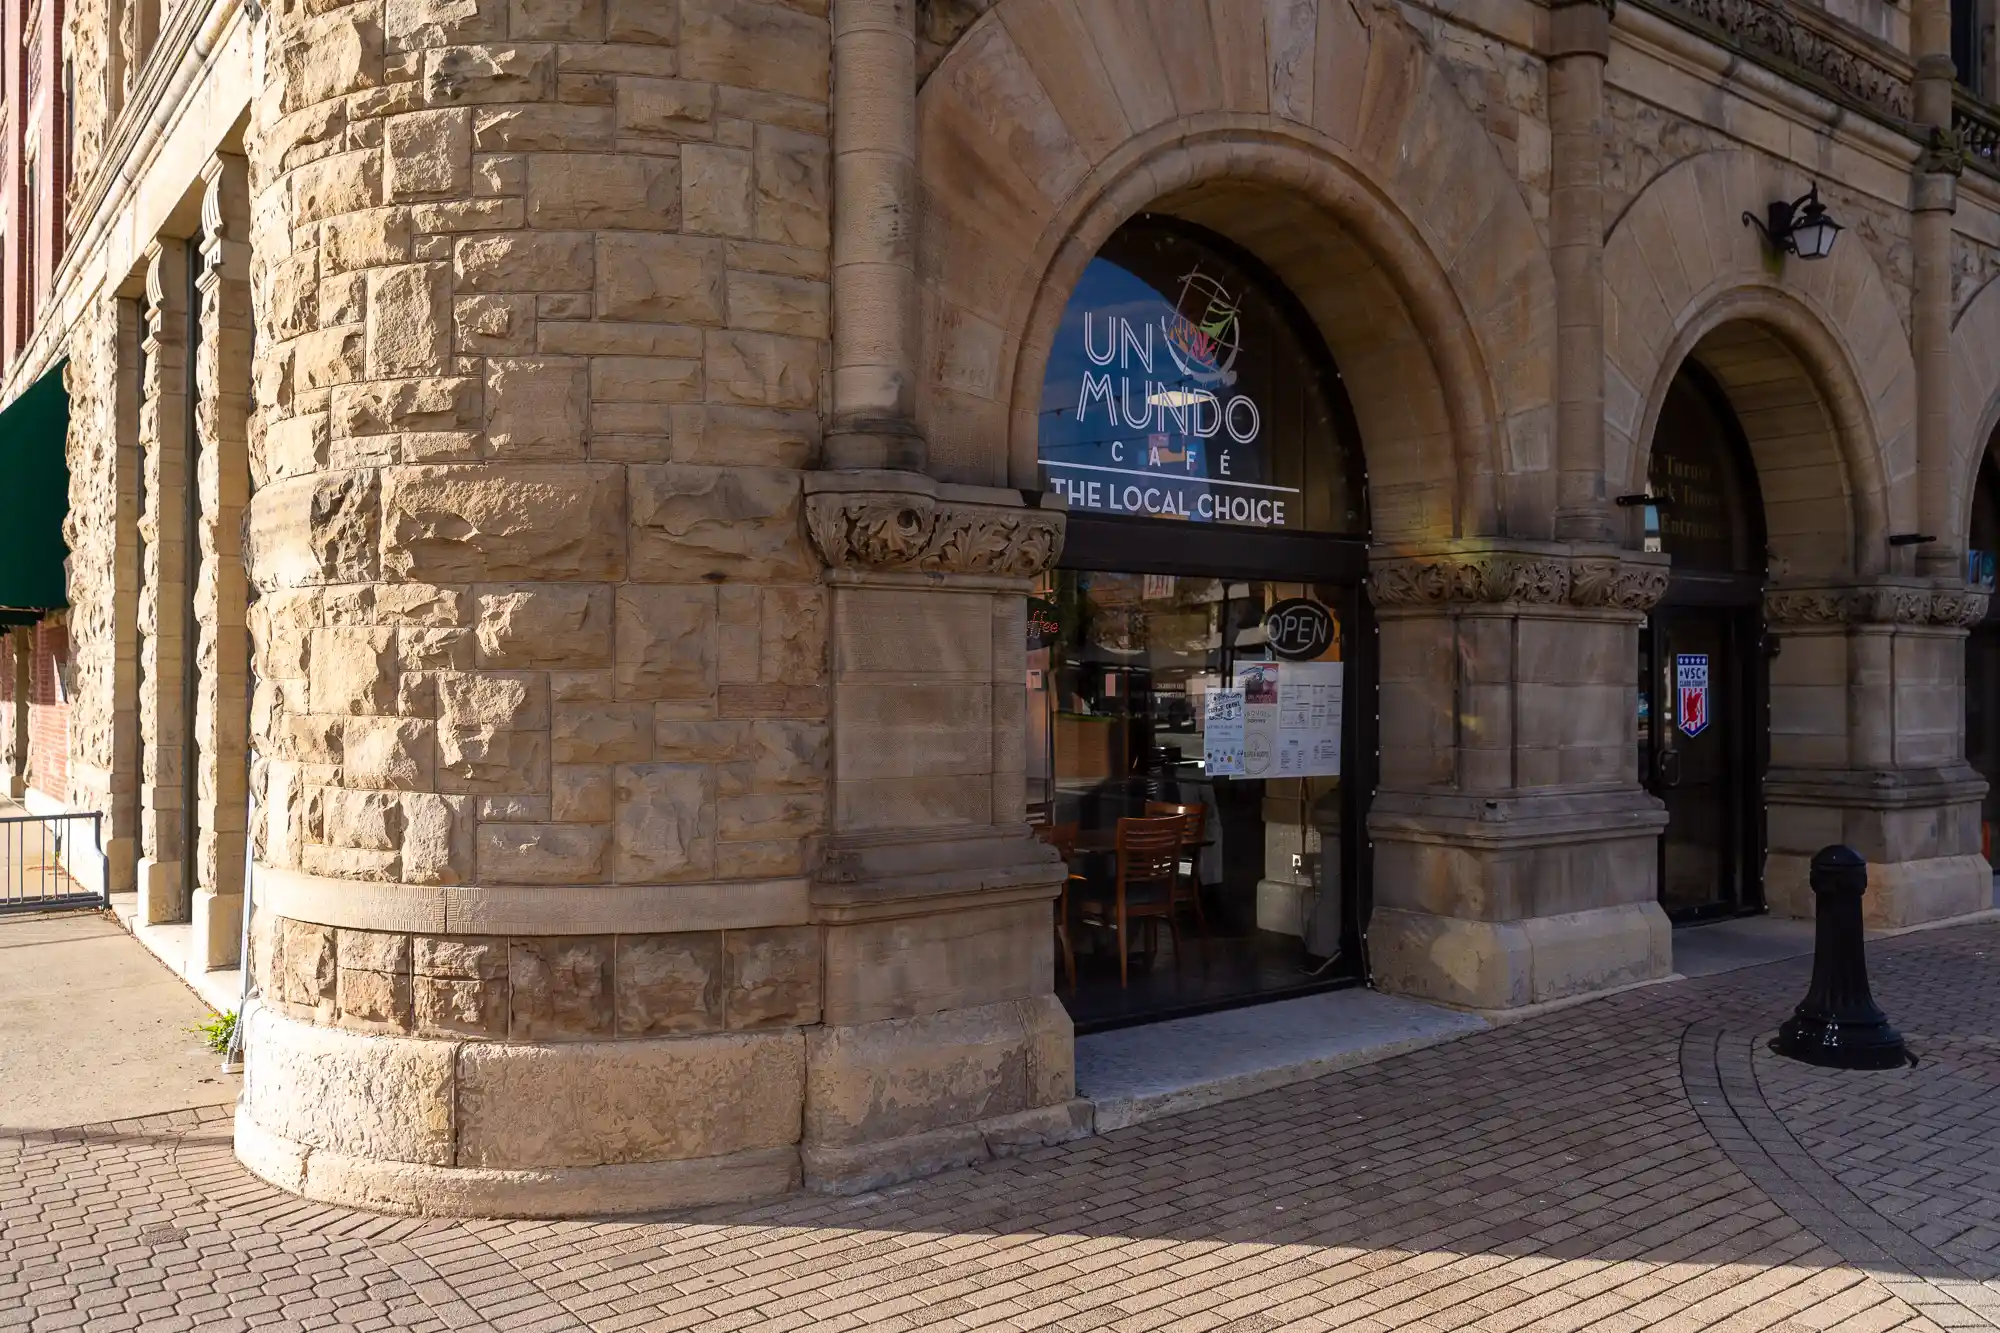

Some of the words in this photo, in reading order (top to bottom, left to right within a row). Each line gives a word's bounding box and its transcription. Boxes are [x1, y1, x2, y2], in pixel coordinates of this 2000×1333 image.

[1084, 311, 1153, 374] UN
[1076, 370, 1261, 444] MUNDO
[1111, 440, 1231, 476] CAFÉ
[1050, 477, 1101, 509] THE
[1109, 485, 1191, 517] LOCAL
[1197, 493, 1286, 525] CHOICE
[1027, 607, 1060, 639] ffee
[1267, 615, 1328, 645] OPEN
[1683, 667, 1702, 680] VSC
